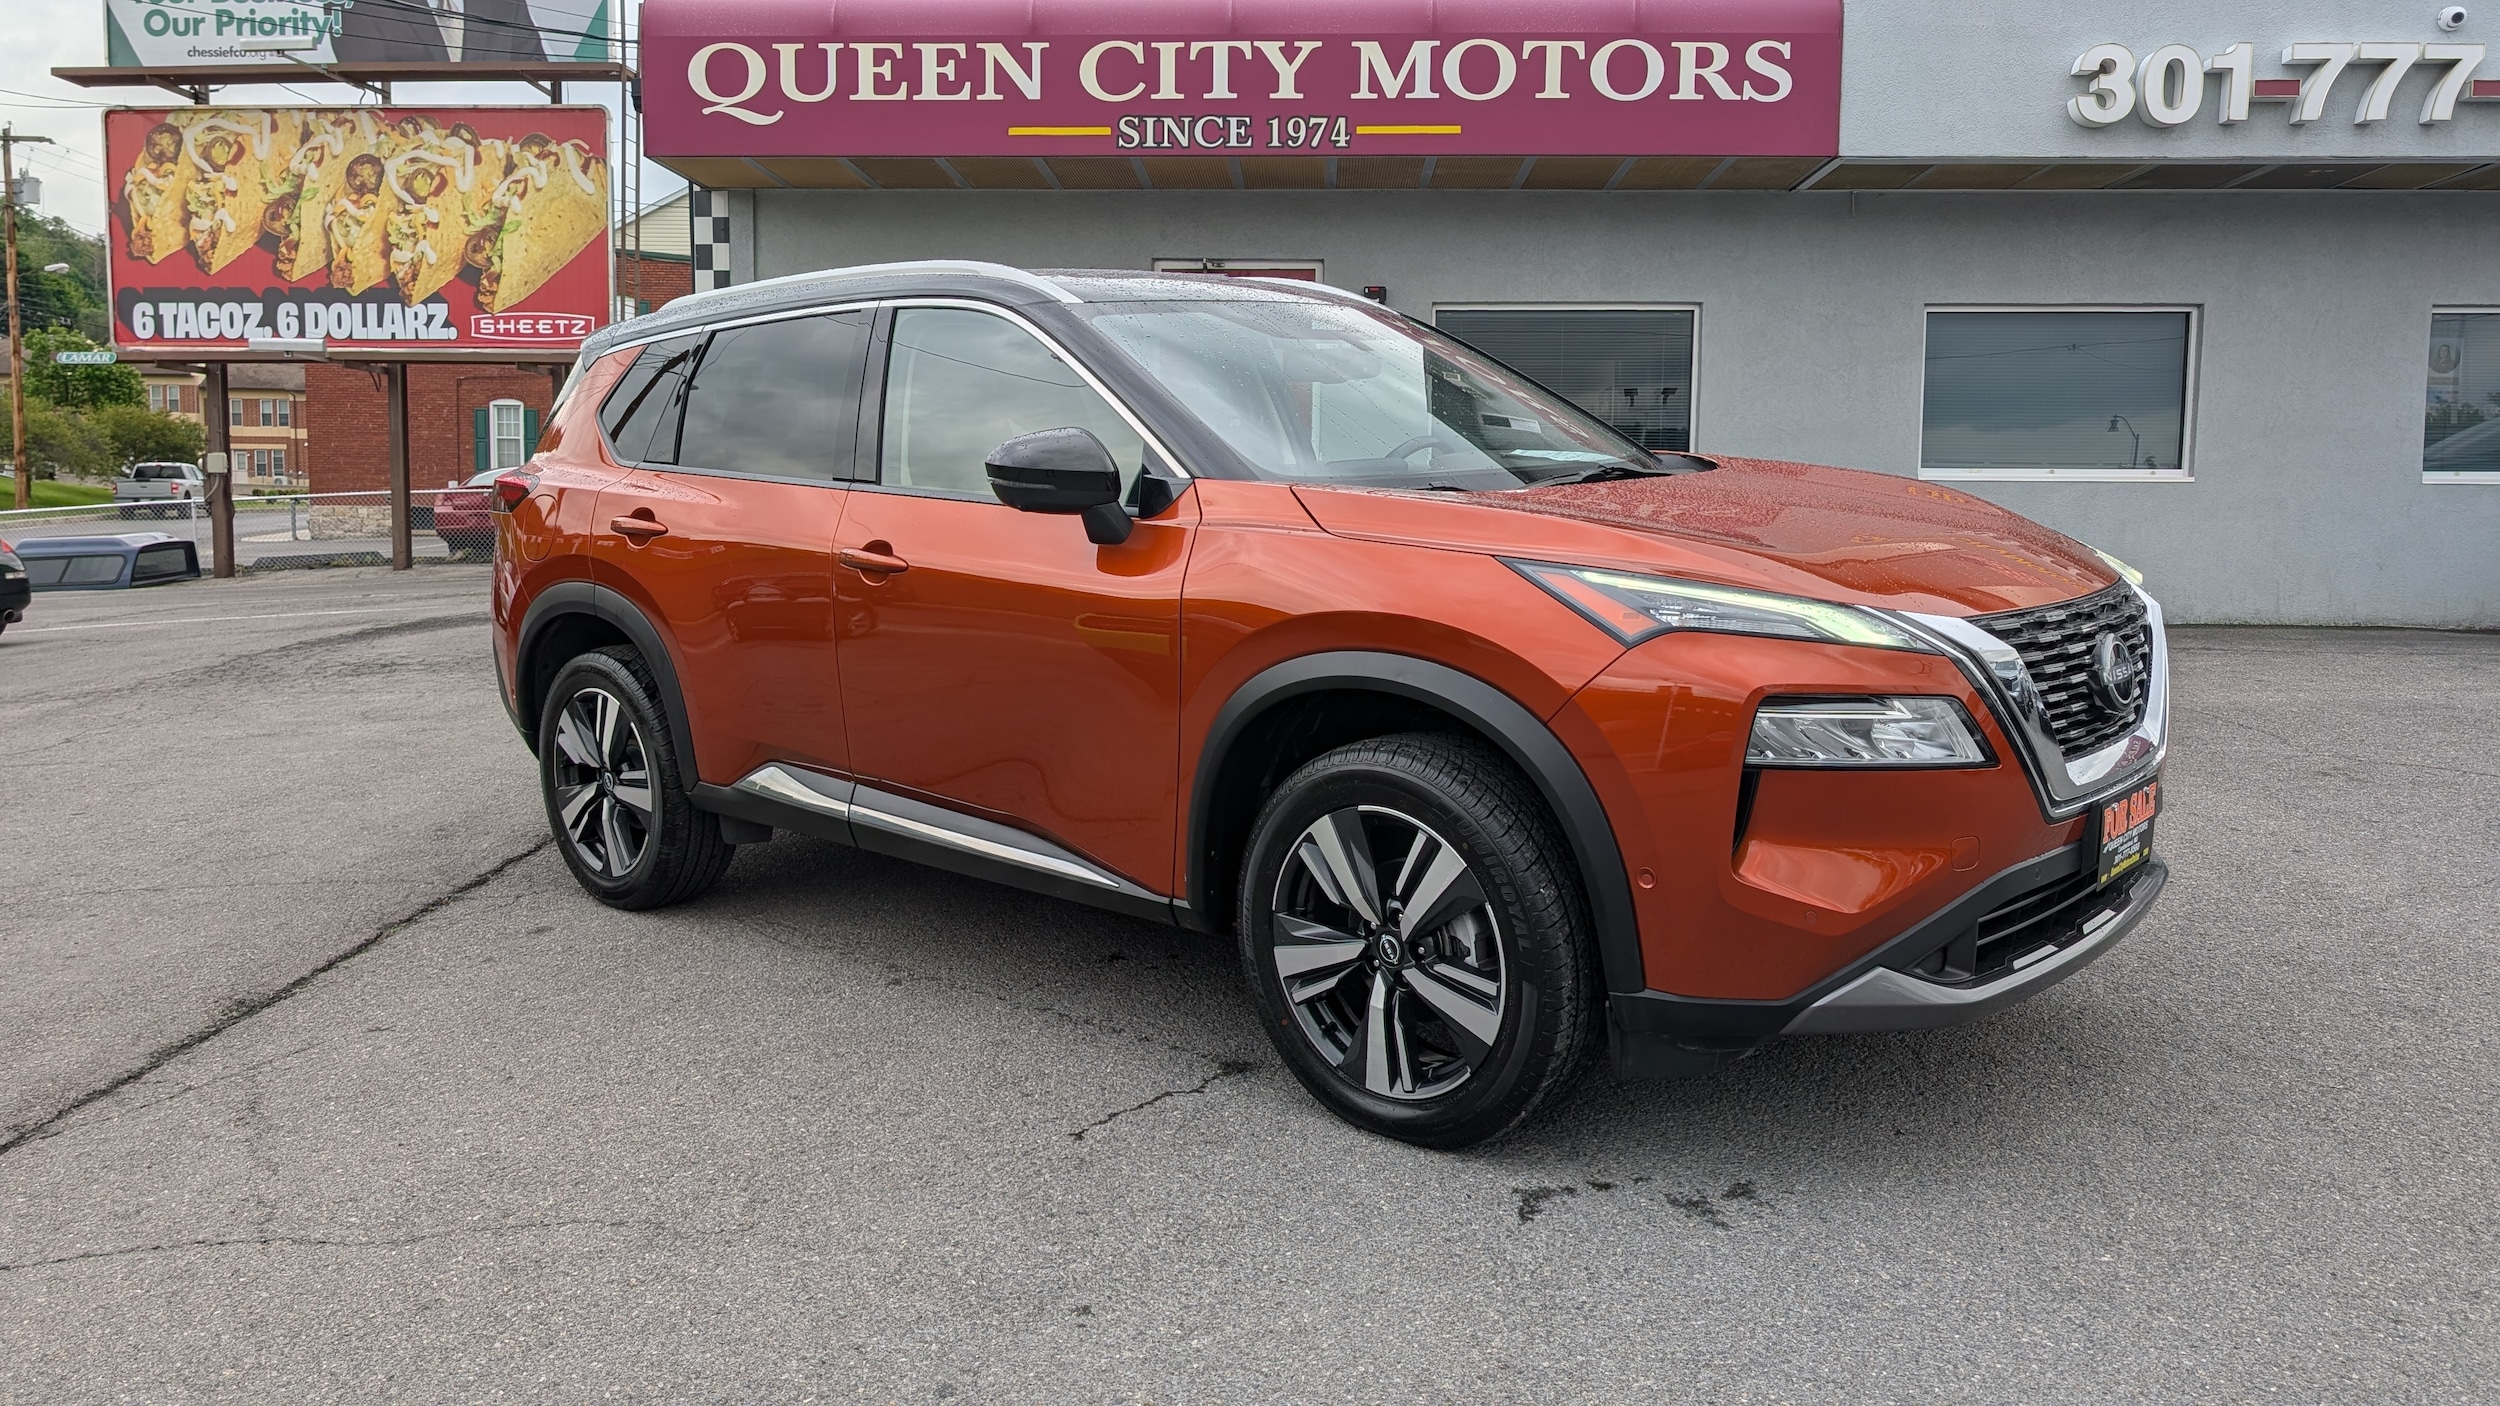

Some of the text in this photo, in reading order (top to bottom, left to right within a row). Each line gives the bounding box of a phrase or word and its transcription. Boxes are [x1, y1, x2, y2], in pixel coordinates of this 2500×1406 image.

[144, 7, 343, 44] Our Priority!
[687, 38, 1793, 126] QUEEN CITY MOTORS
[1117, 115, 1351, 148] SINCE 1974
[132, 302, 459, 340] 6 TACOZ. 6 DOLLARZ.
[480, 319, 586, 334] SHEETZ
[62, 354, 111, 362] LAMAR
[2103, 664, 2132, 683] NISSA
[2103, 782, 2157, 844] FOR SALE
[1457, 819, 1532, 951] UNIROYAL
